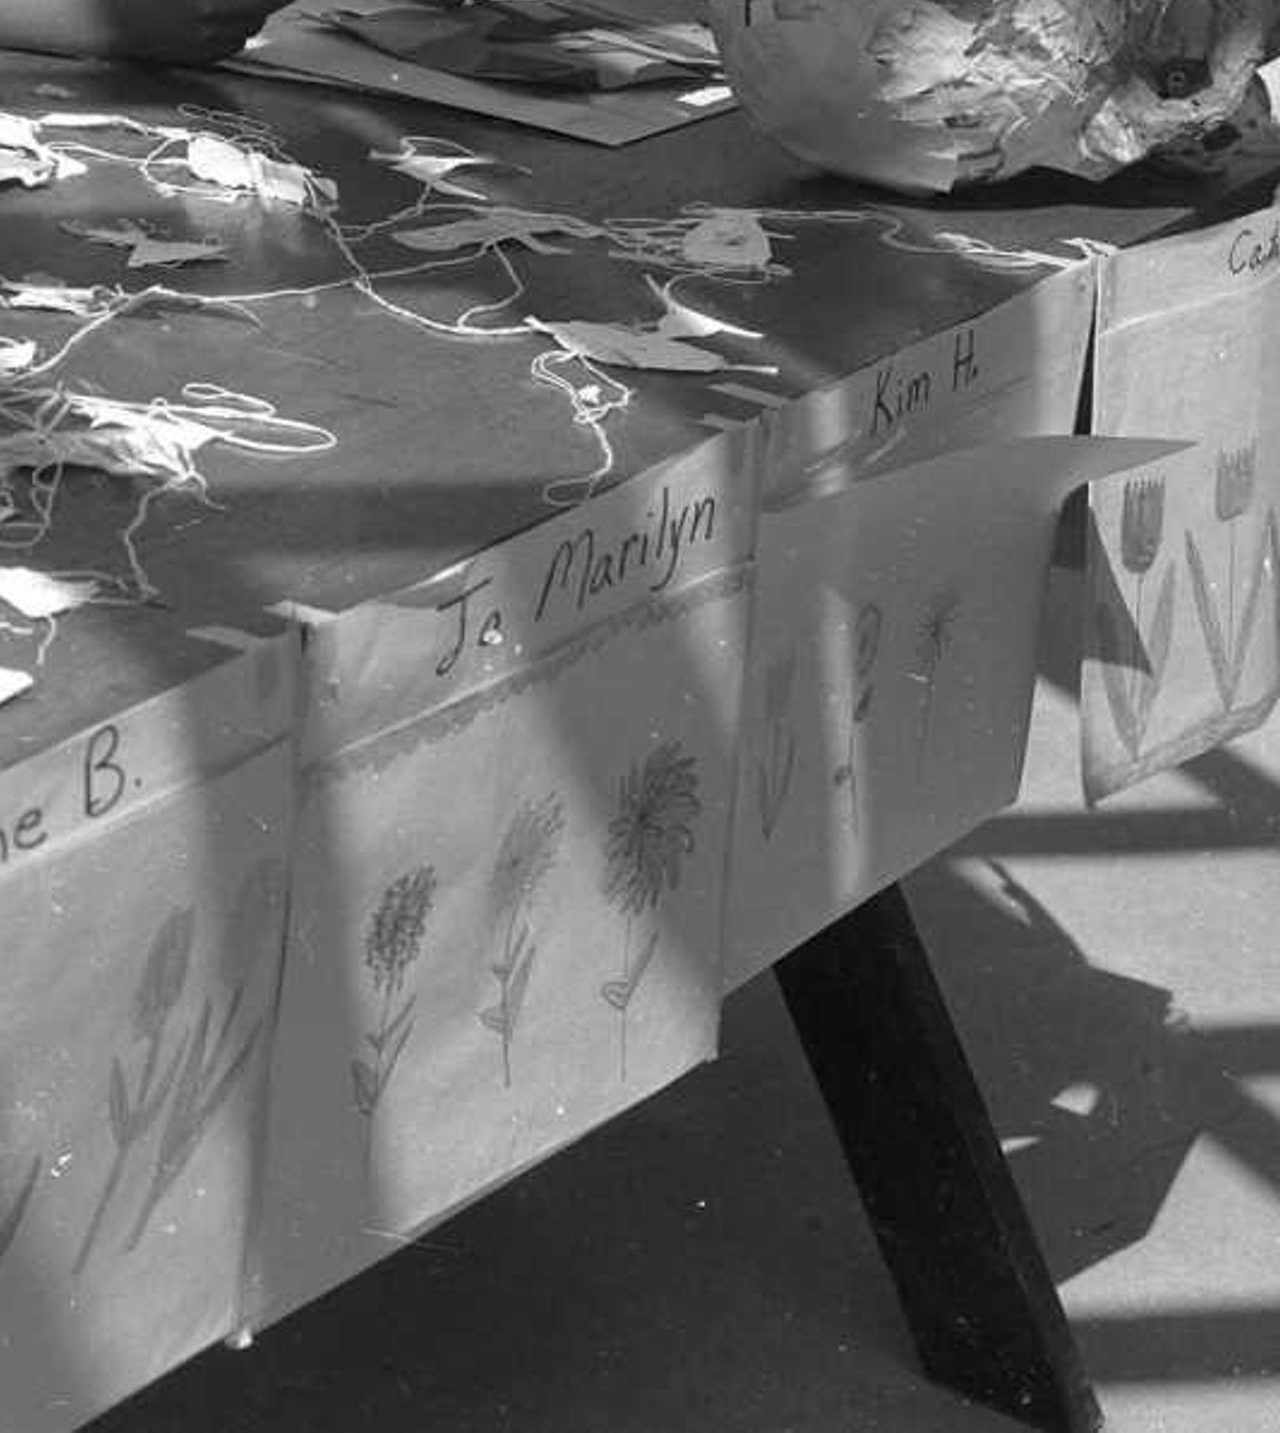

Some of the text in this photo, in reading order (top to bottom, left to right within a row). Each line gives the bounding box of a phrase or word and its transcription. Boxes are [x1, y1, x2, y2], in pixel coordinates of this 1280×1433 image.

[870, 328, 978, 437] Kim H.
[535, 486, 716, 622] Marilyn
[84, 724, 142, 818] B.
